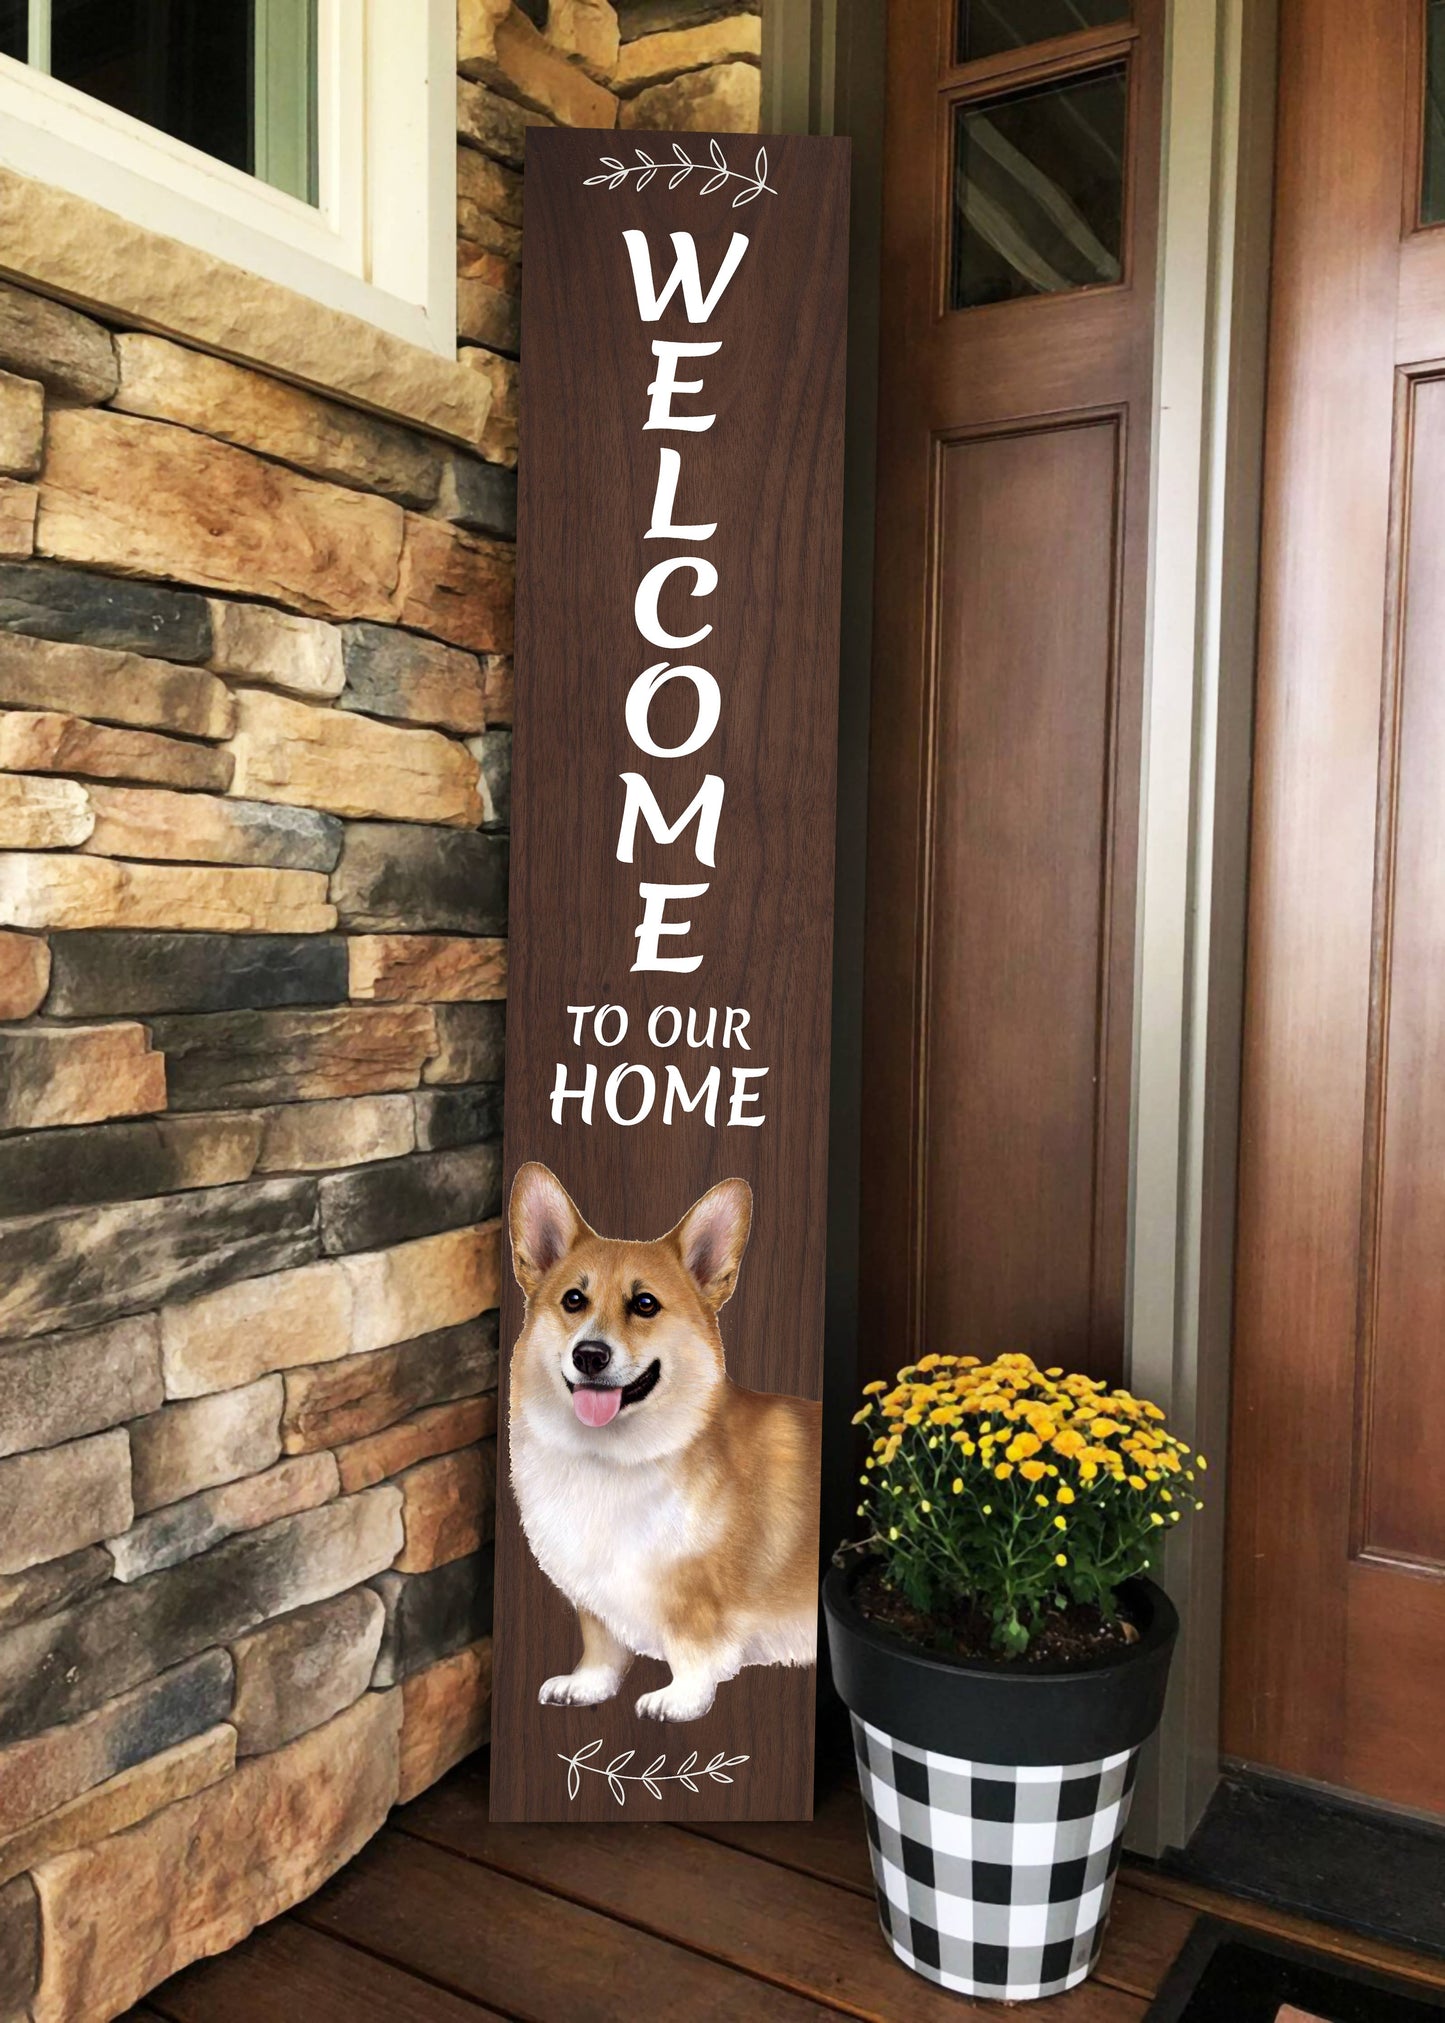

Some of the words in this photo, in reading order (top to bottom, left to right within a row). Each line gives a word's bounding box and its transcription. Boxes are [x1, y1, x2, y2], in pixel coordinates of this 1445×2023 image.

[616, 229, 750, 974] WELCOME
[566, 1003, 629, 1047] TO
[647, 1004, 752, 1051] OUR
[549, 1062, 770, 1128] HOME
